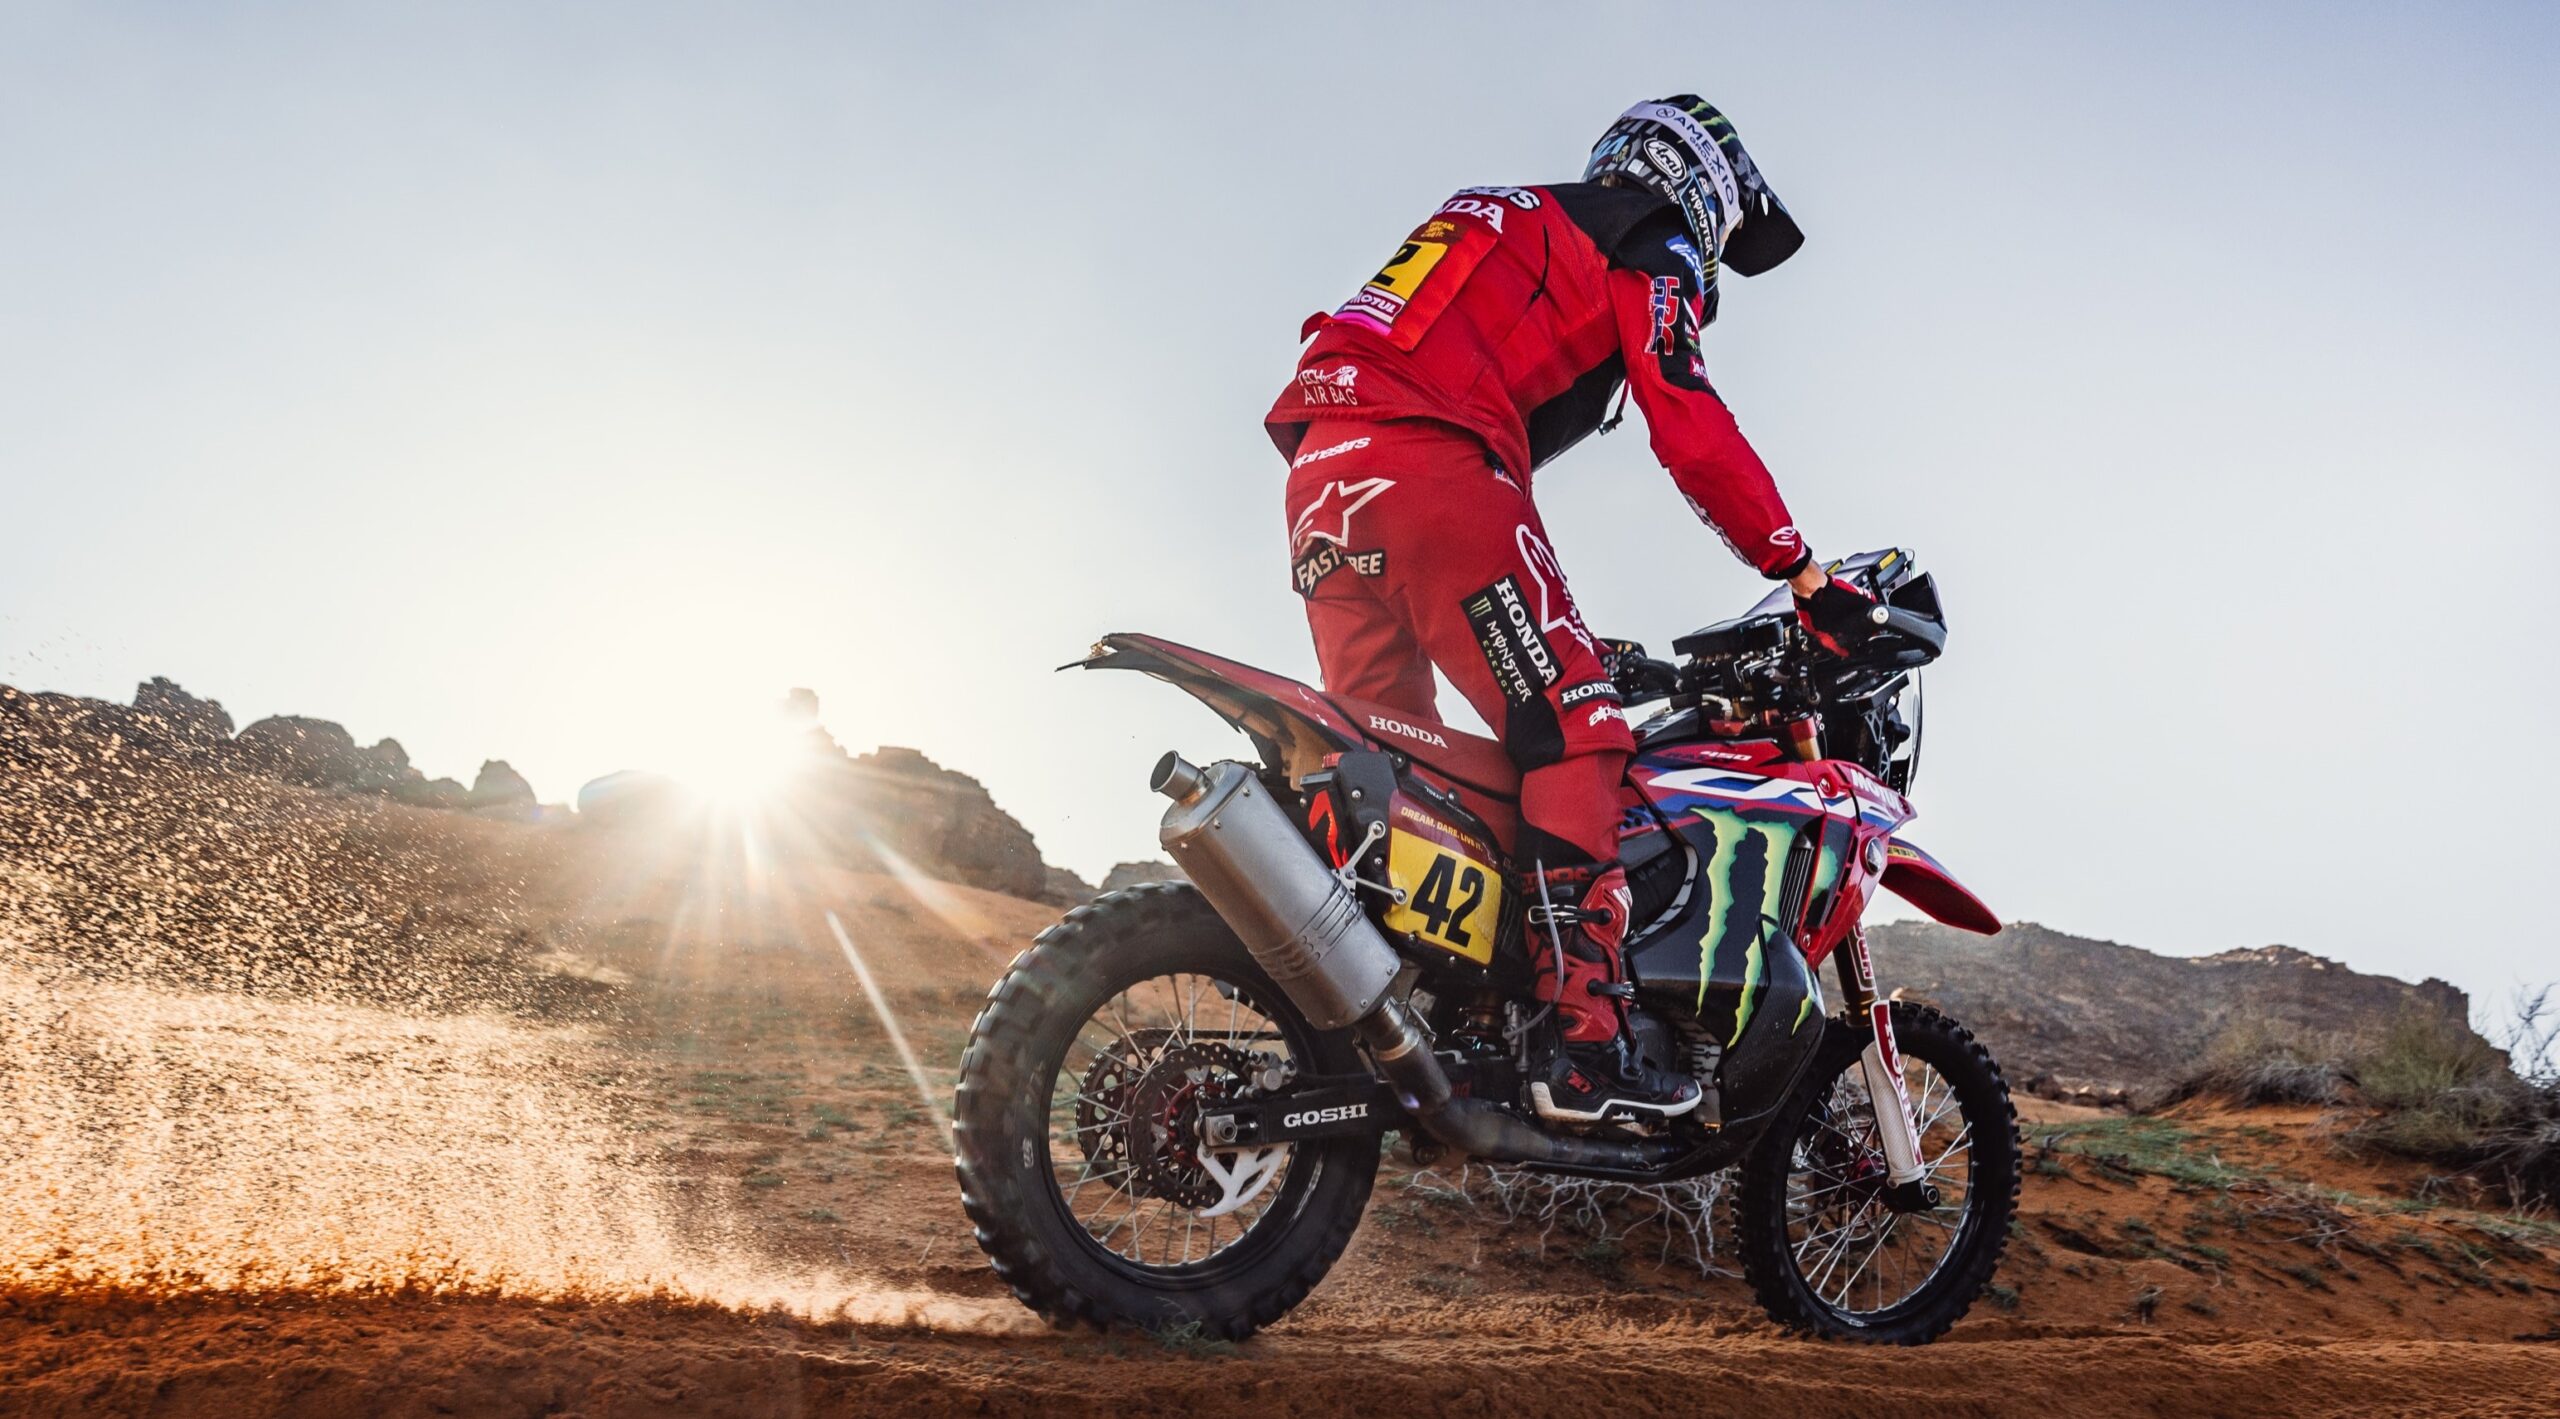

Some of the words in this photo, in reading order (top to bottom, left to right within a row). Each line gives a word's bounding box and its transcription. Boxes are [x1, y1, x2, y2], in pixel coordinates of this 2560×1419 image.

[1648, 140, 1683, 178] Arai
[1674, 116, 1734, 206] AMEXIO
[1303, 386, 1329, 406] AIR
[1329, 386, 1358, 406] BAG
[1494, 577, 1558, 687] HONDA
[1482, 639, 1513, 696] ENERGY
[1486, 619, 1532, 703] MONSTER
[1368, 714, 1449, 750] HONDA
[1410, 853, 1485, 948] 42
[1283, 1103, 1368, 1129] GOSHI
